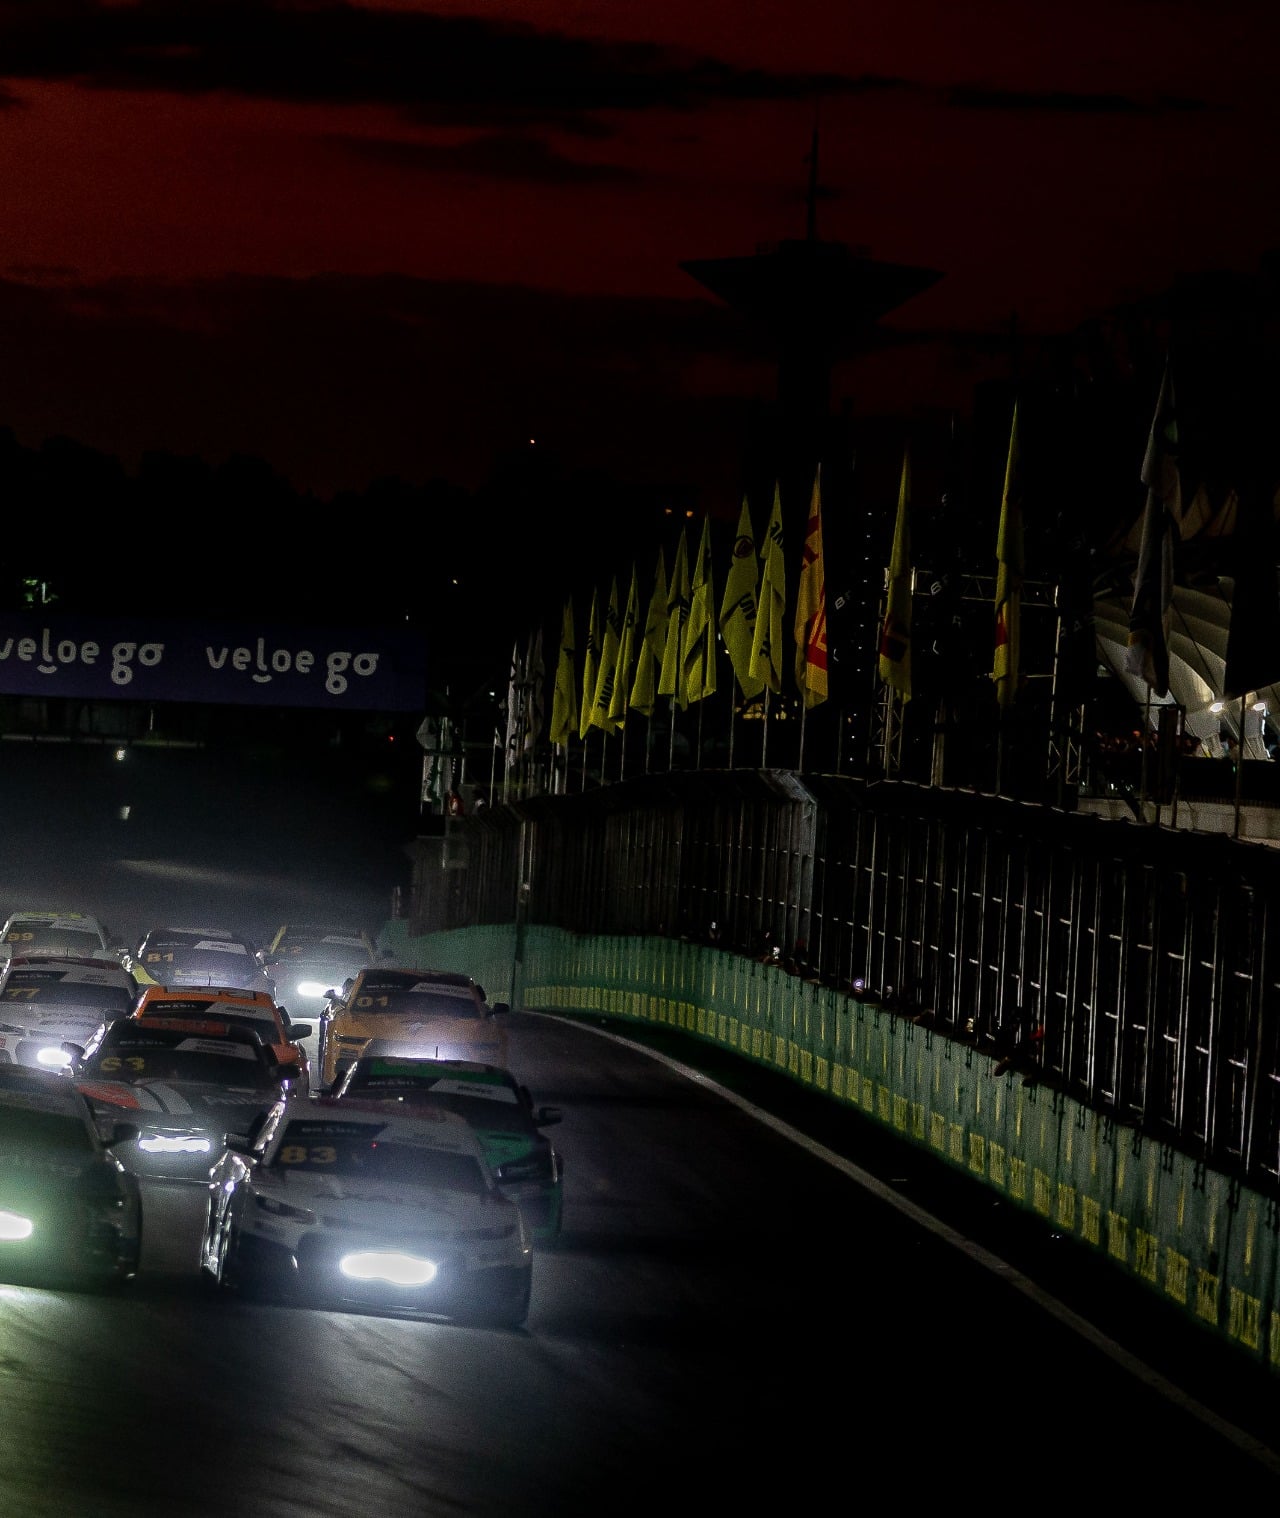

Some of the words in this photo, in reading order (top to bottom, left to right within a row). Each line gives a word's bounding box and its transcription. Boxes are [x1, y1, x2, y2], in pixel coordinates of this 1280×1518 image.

[111, 642, 165, 685] go
[206, 638, 315, 674] veloe
[325, 652, 379, 694] go
[280, 1145, 337, 1164] 83
